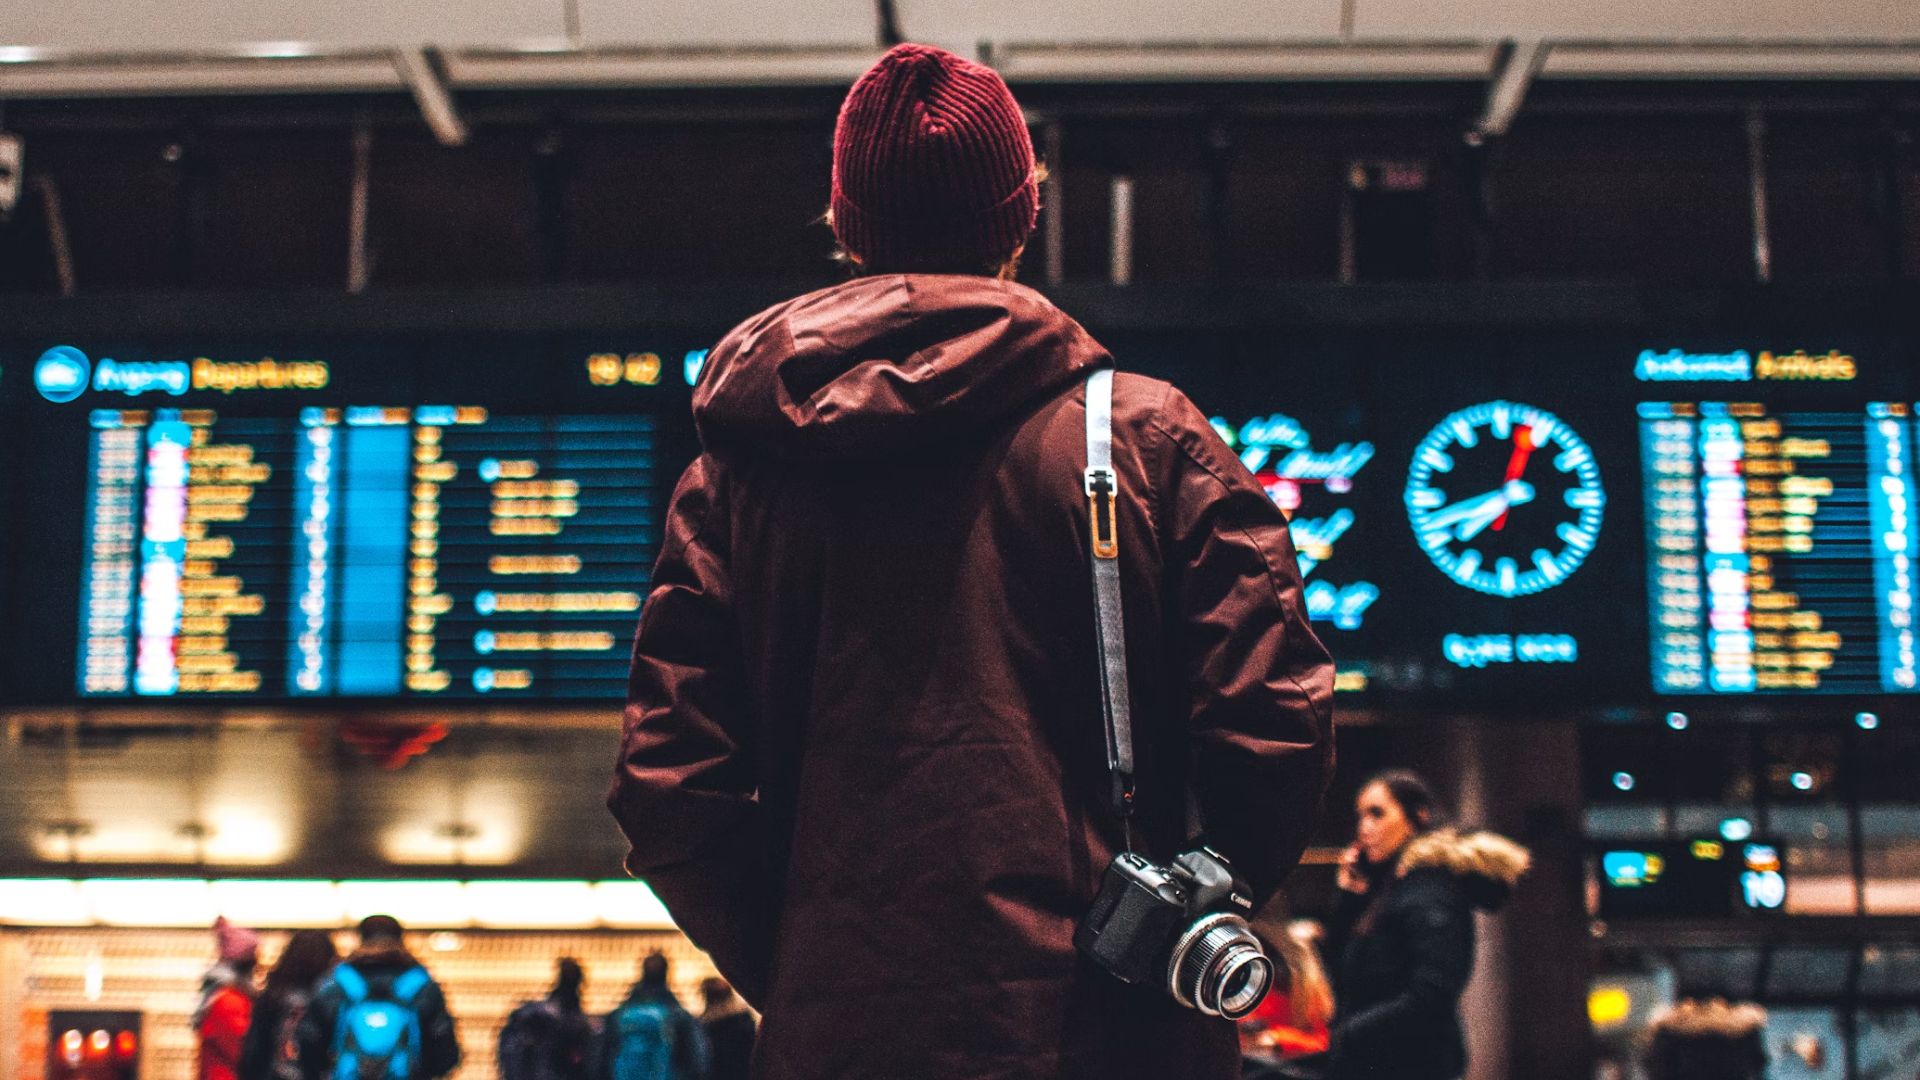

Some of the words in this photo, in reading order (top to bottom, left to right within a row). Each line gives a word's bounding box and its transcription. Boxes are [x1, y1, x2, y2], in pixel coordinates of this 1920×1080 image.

[192, 357, 329, 394] Departures
[1756, 349, 1857, 380] Arrivals
[1230, 892, 1252, 909] Canon
